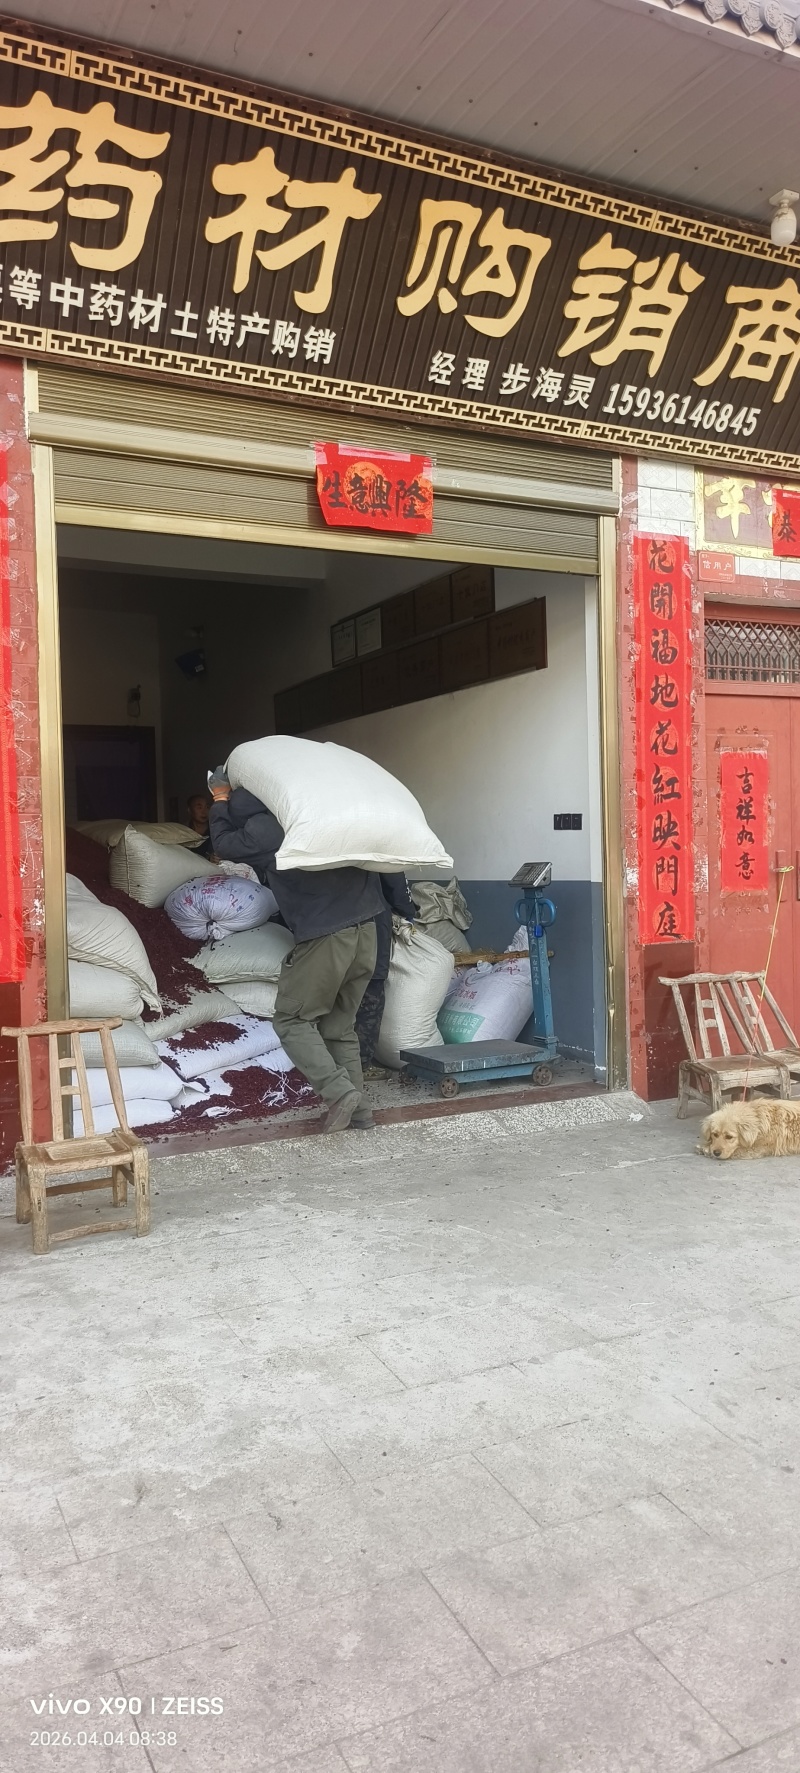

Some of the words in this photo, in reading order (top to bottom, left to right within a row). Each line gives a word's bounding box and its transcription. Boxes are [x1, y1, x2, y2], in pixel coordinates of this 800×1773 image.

[0, 263, 337, 365] 等中药材土特产购销
[428, 351, 489, 391] 经理
[499, 362, 596, 409] 步海灵
[603, 383, 761, 436] 15936146845
[702, 560, 732, 571] 信用户
[735, 767, 756, 880] 吉祥如意
